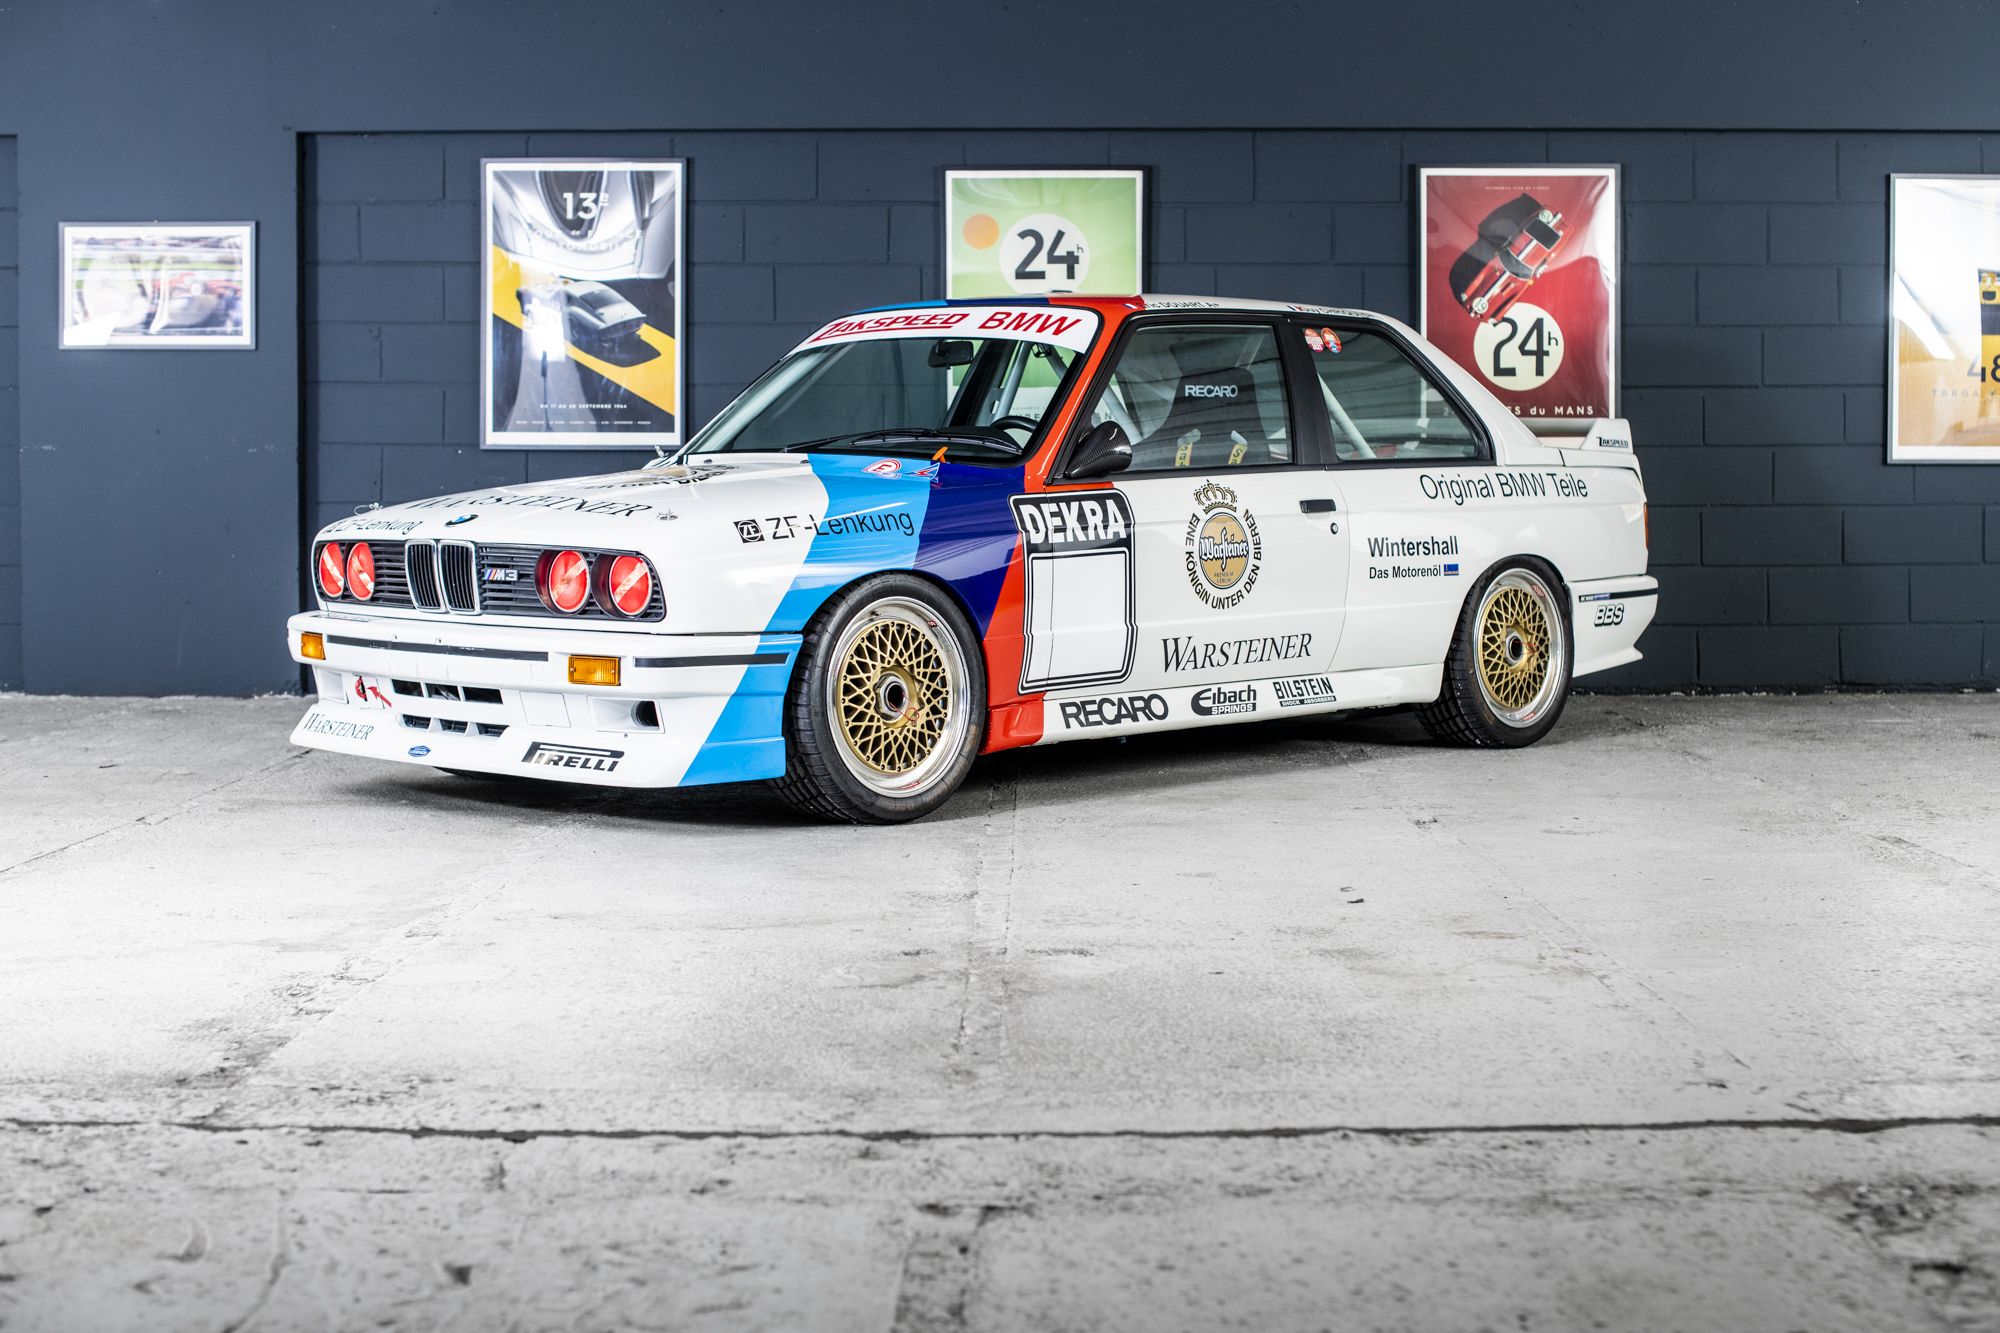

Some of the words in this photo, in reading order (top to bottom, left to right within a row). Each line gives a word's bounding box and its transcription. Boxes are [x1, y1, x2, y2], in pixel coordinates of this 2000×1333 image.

[808, 313, 969, 344] ZAKSPEED
[978, 311, 1082, 336] BMW
[1185, 384, 1239, 398] RECARO
[1932, 388, 1979, 398] TARGA
[1530, 406, 1546, 415] du
[1554, 406, 1594, 415] MANS
[1419, 473, 1495, 506] Original
[1496, 472, 1546, 498] BMW
[1547, 472, 1589, 498] Teile
[739, 524, 758, 537] ZF
[766, 511, 915, 537] ZF-Lenkung
[1019, 499, 1127, 544] DEKRA
[1186, 513, 1200, 547] EINE
[1243, 509, 1262, 561] BIEREN
[1367, 535, 1459, 558] Wintershall
[1185, 551, 1211, 605] KÖNIGIN
[1243, 564, 1260, 594] DEN
[1369, 566, 1389, 579] Das
[1392, 564, 1441, 579] Motorenöl
[1211, 589, 1245, 610] UNTER
[1594, 603, 1625, 627] BBS
[1161, 632, 1312, 673] WARSTEINER
[1191, 684, 1256, 716] Eibach
[1272, 676, 1334, 700] BILSTEIN
[1059, 693, 1169, 729] RECARO
[1212, 702, 1254, 714] SPRINGS
[303, 713, 375, 741] WARSTEINER
[521, 741, 625, 772] PIRELLI
